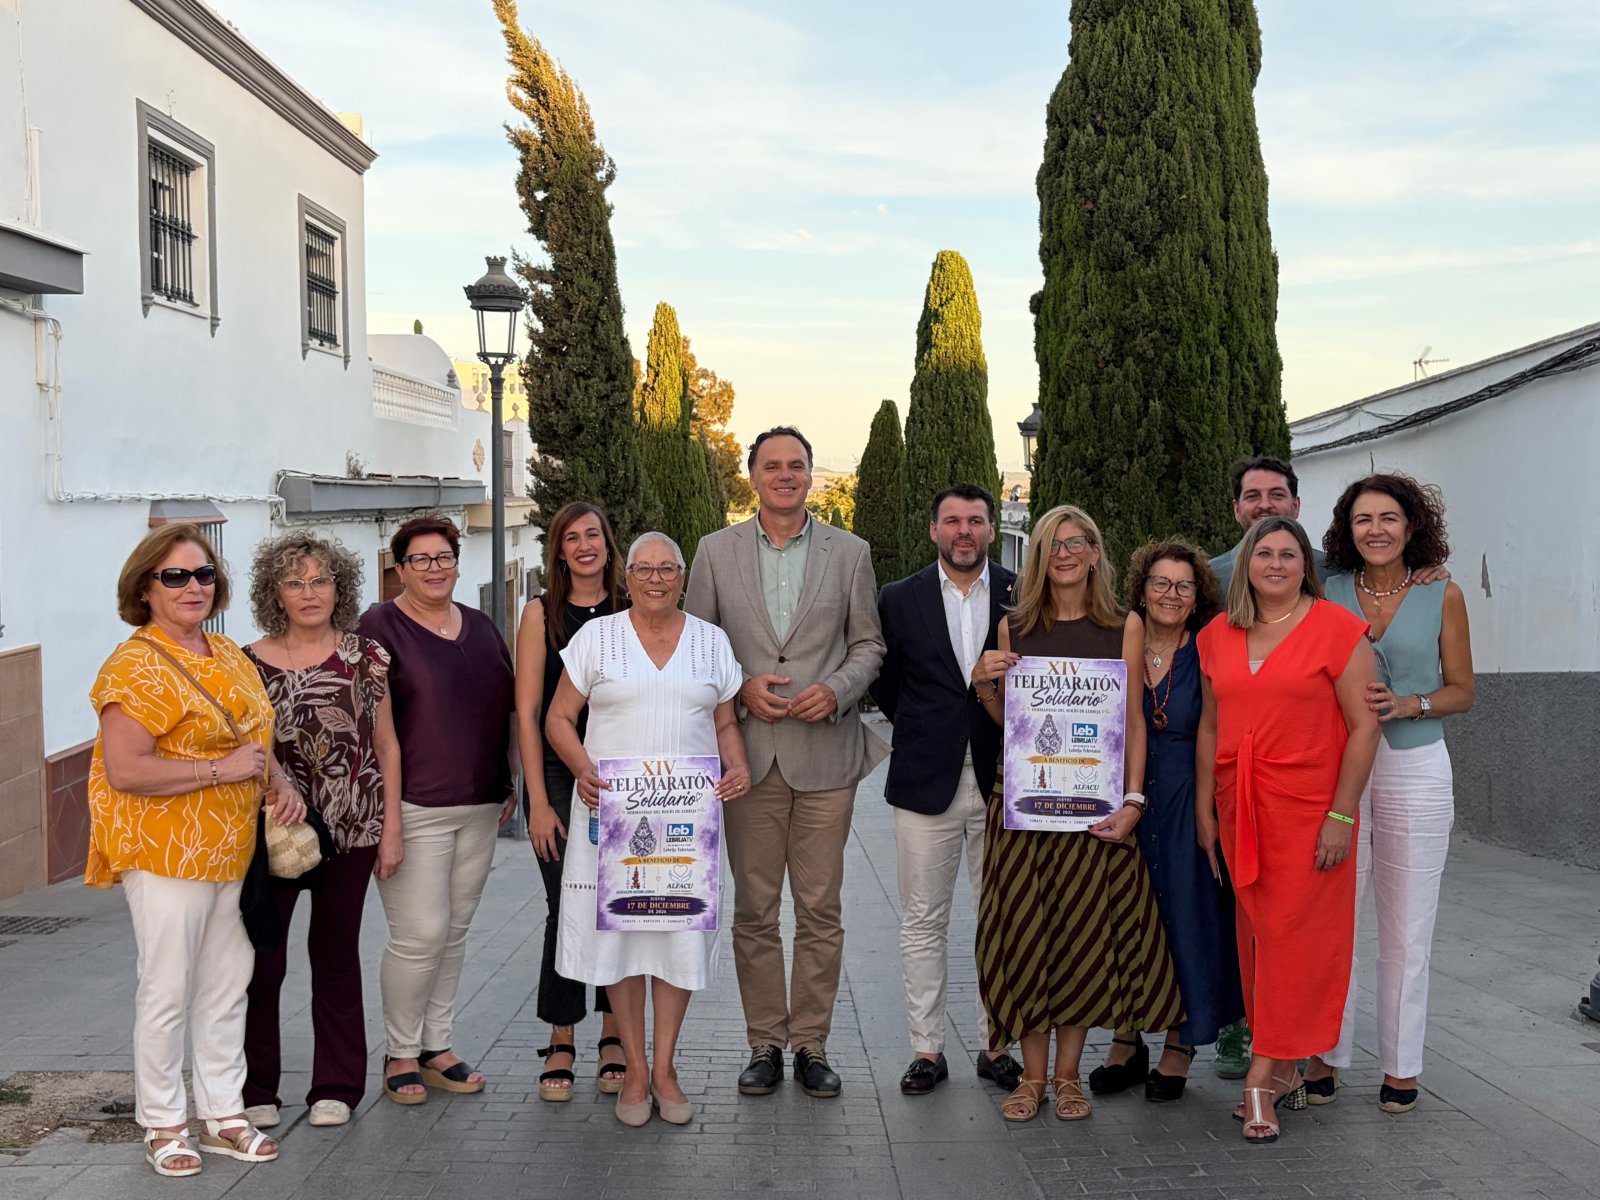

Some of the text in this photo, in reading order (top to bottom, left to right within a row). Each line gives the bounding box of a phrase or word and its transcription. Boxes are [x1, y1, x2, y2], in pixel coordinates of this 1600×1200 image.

[1048, 661, 1082, 675] XIV
[1012, 674, 1120, 692] TELEMARATÓN
[1031, 688, 1101, 707] Solidario
[1073, 724, 1094, 735] Leb
[642, 760, 677, 776] XIV
[606, 772, 715, 792] TELEMARATÓN
[626, 790, 696, 810] Solidario
[668, 825, 690, 835] Leb
